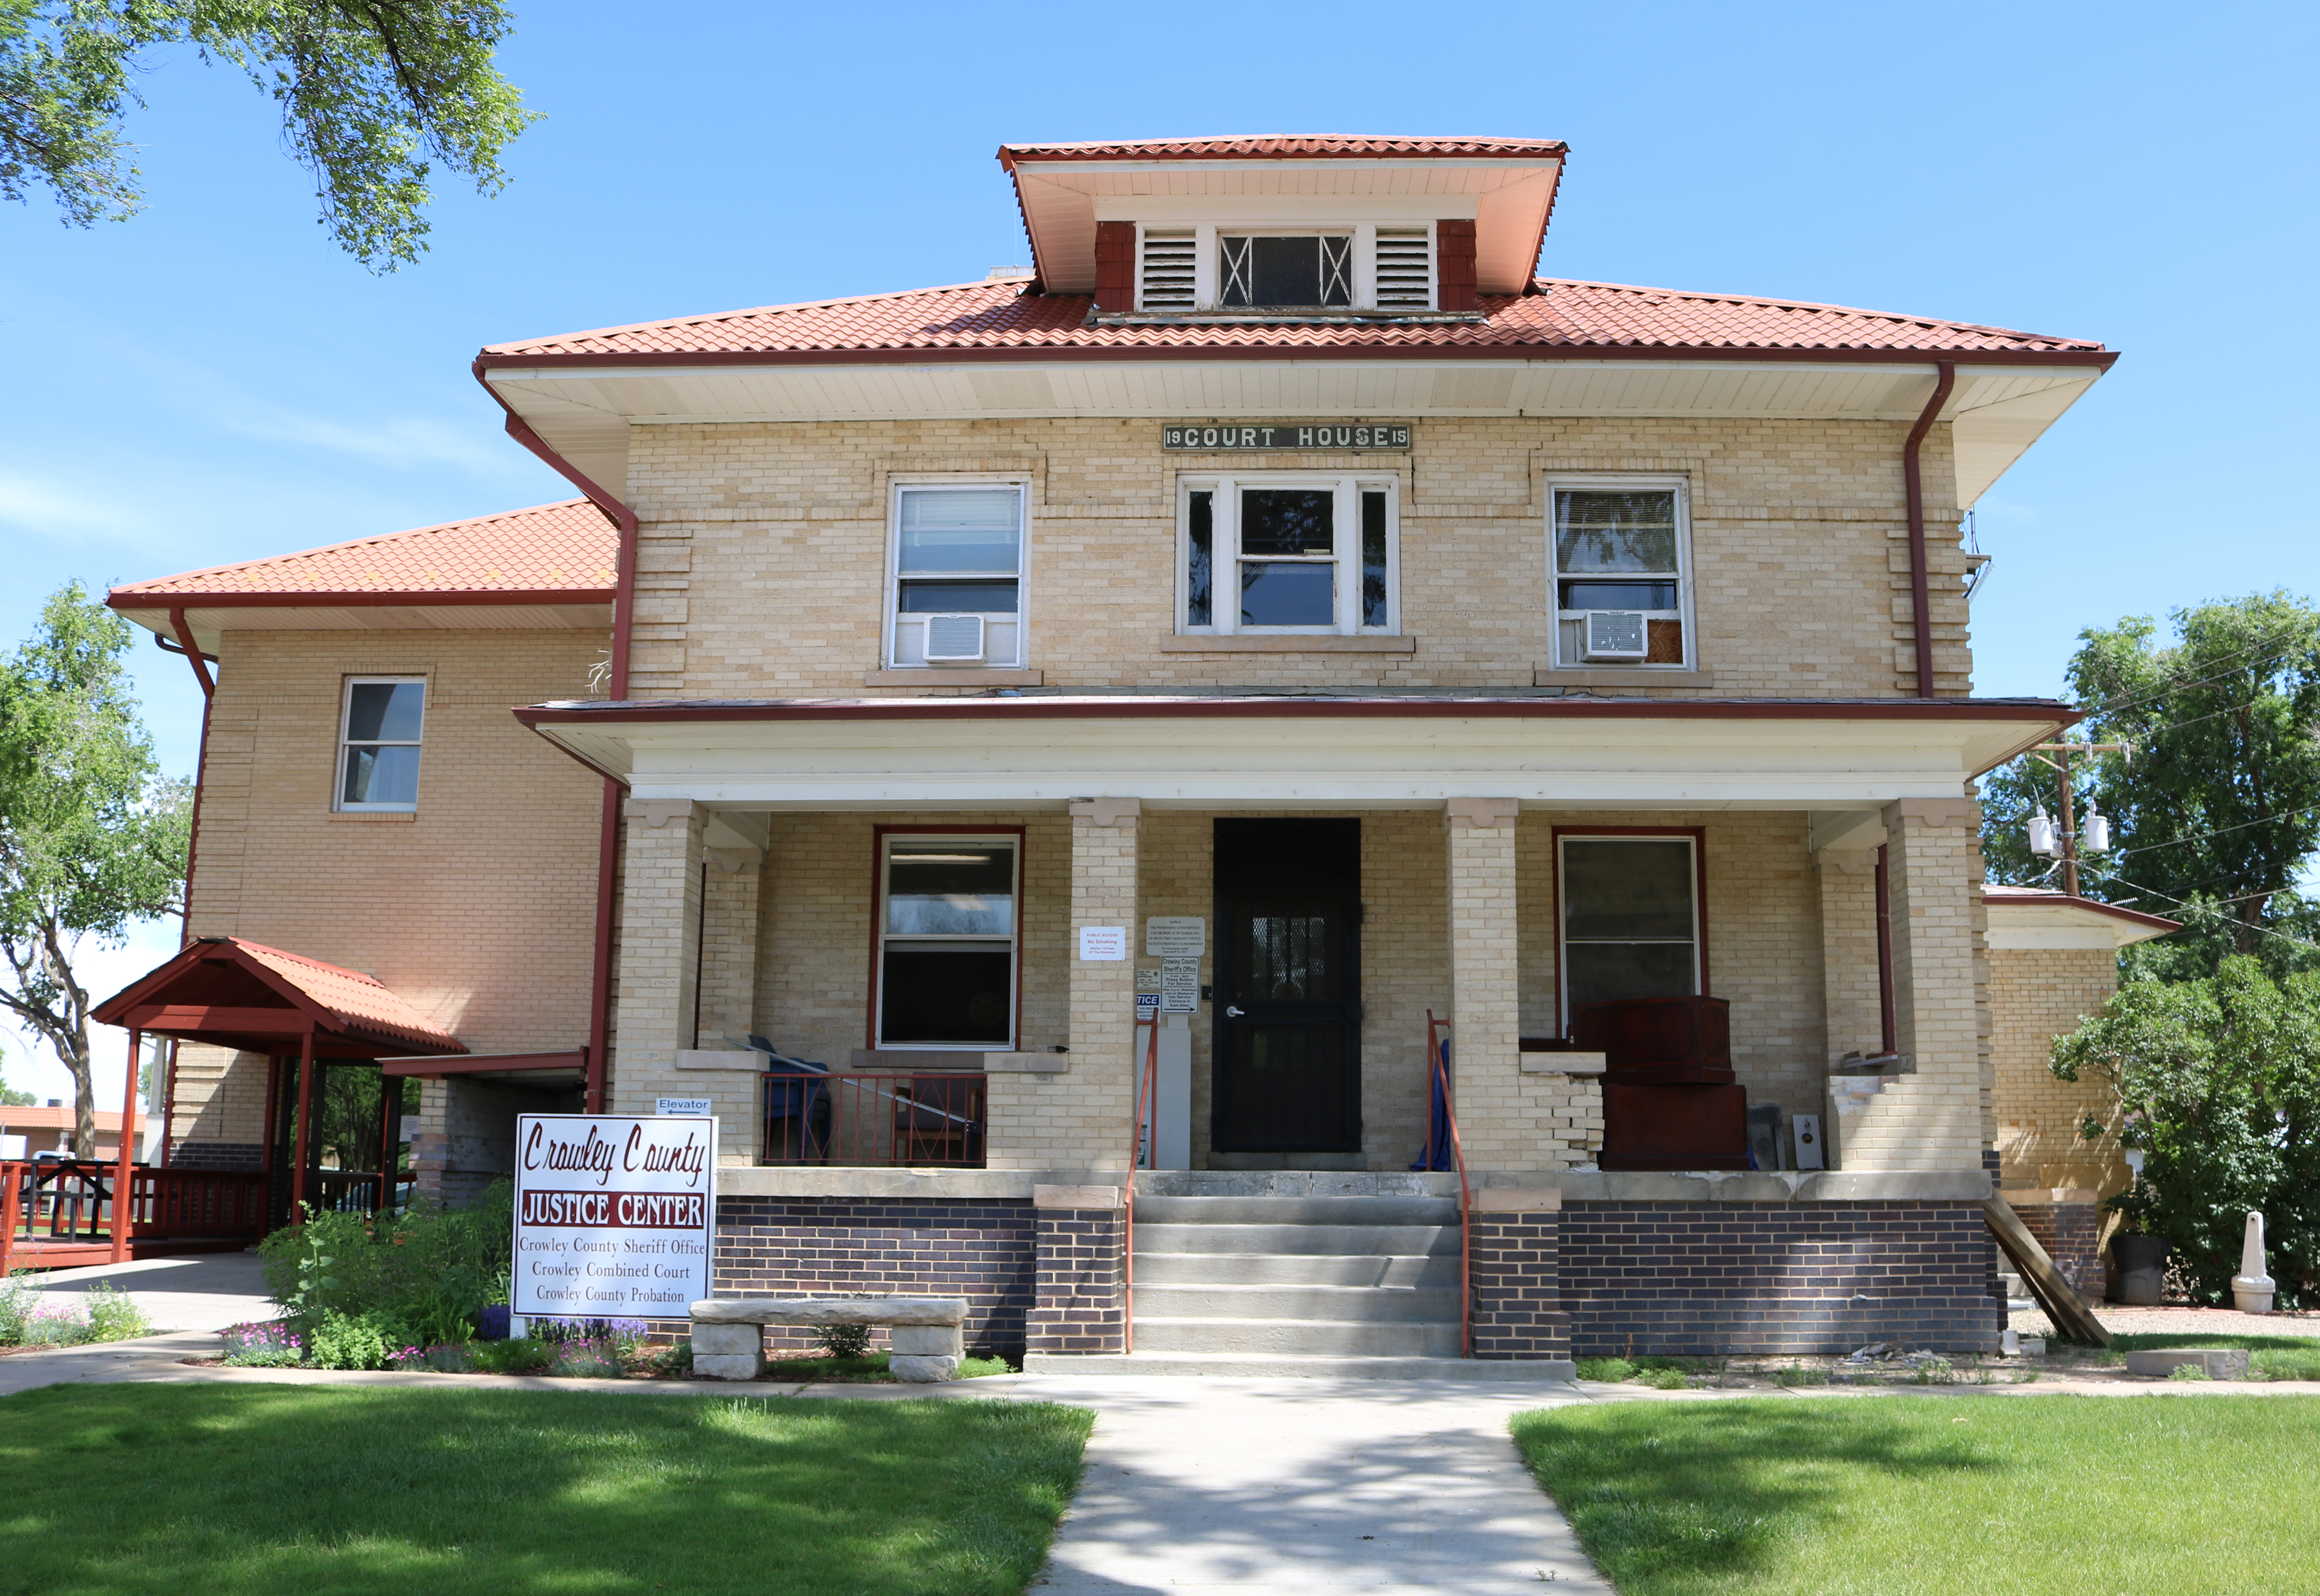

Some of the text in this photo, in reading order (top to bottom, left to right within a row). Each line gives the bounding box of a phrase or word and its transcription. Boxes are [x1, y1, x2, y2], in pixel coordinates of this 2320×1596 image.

[1167, 427, 1407, 446] 19 COURT HOUSE 15
[1137, 996, 1158, 1004] TICE
[660, 1100, 707, 1108] Elevator
[524, 1122, 705, 1187] Crowley County
[523, 1193, 702, 1226] JUSTICE CENTER
[520, 1237, 705, 1257] Crowley County Sheriff Office
[532, 1261, 690, 1282] Crowley Combined Court
[537, 1285, 684, 1307] Crowley County Probation
